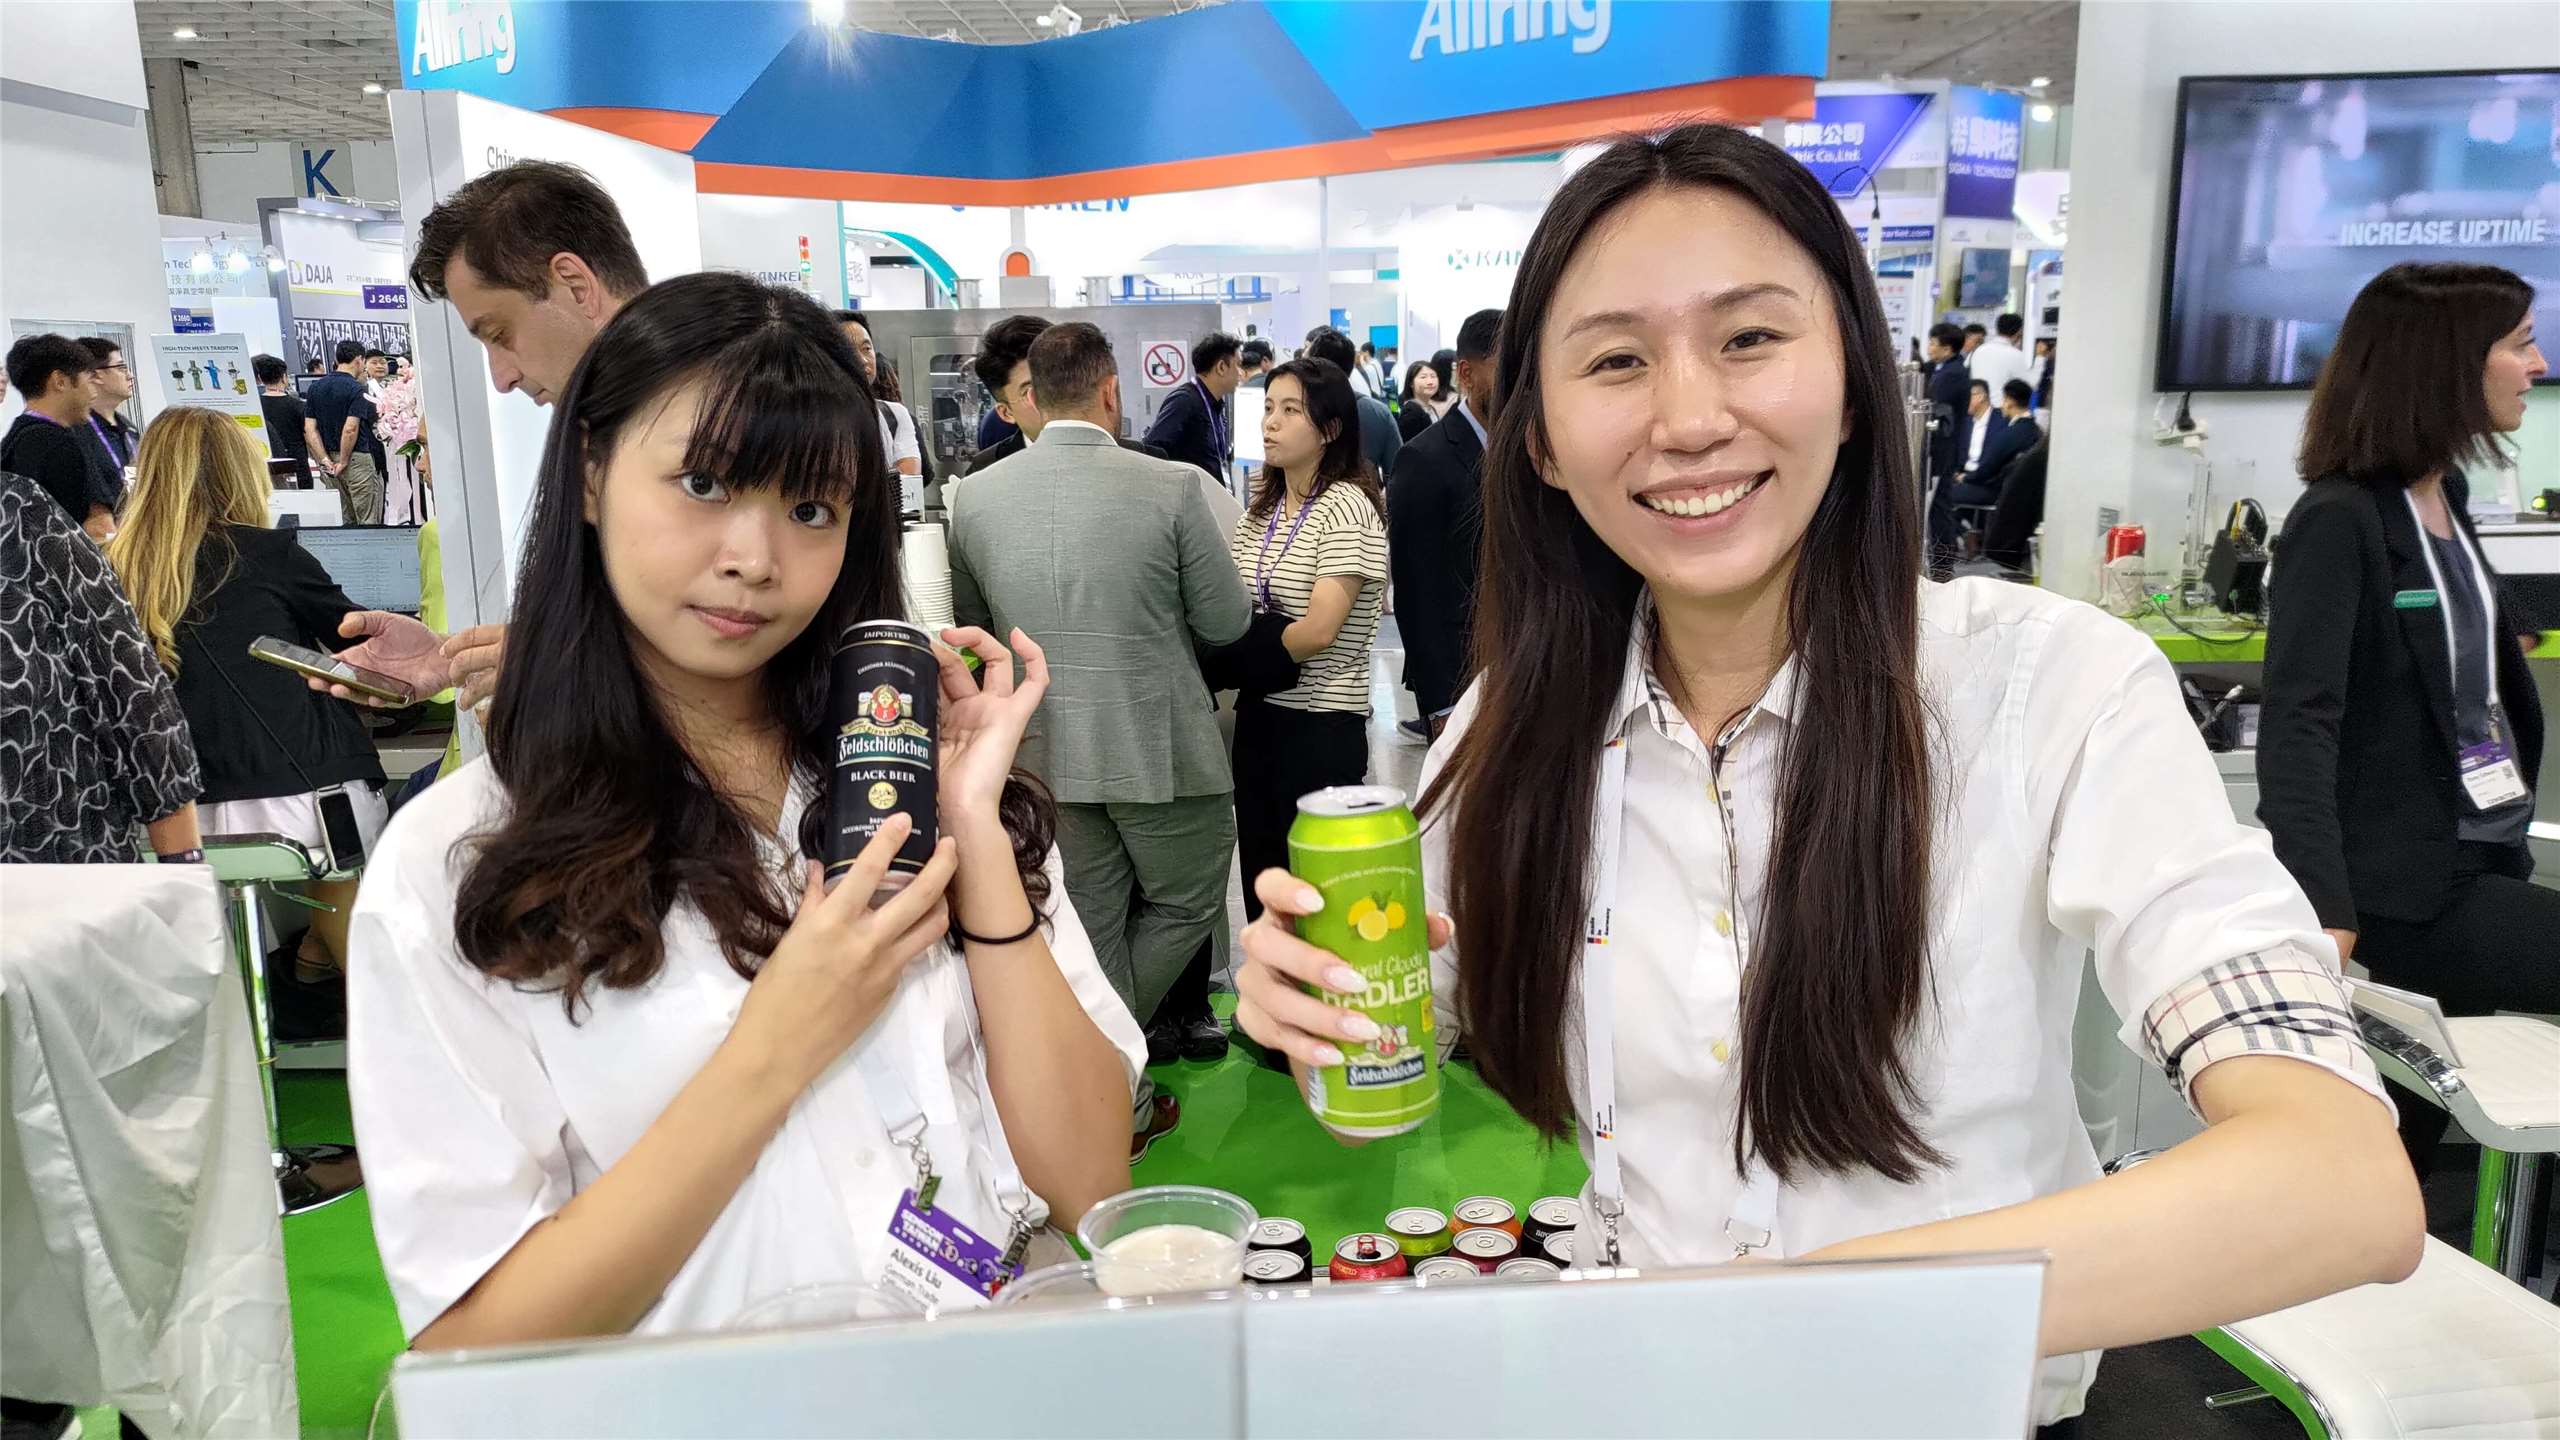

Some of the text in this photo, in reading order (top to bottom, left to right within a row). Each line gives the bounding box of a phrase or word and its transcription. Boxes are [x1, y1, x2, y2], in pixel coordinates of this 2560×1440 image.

[412, 0, 516, 76] Allring
[1409, 0, 1611, 61] Allring
[303, 149, 341, 197] K
[2341, 218, 2547, 246] INCREASE UPTIME
[306, 264, 334, 283] DAJA
[369, 294, 406, 304] J 2646
[325, 321, 353, 341] DAJA
[355, 322, 381, 342] DAJA
[383, 323, 407, 343] DAJA
[864, 631, 910, 640] IMPORTED
[840, 736, 928, 762] Feldschlößchen
[851, 769, 916, 783] BLACK BEER
[891, 1248, 942, 1289] Alexis Liu
